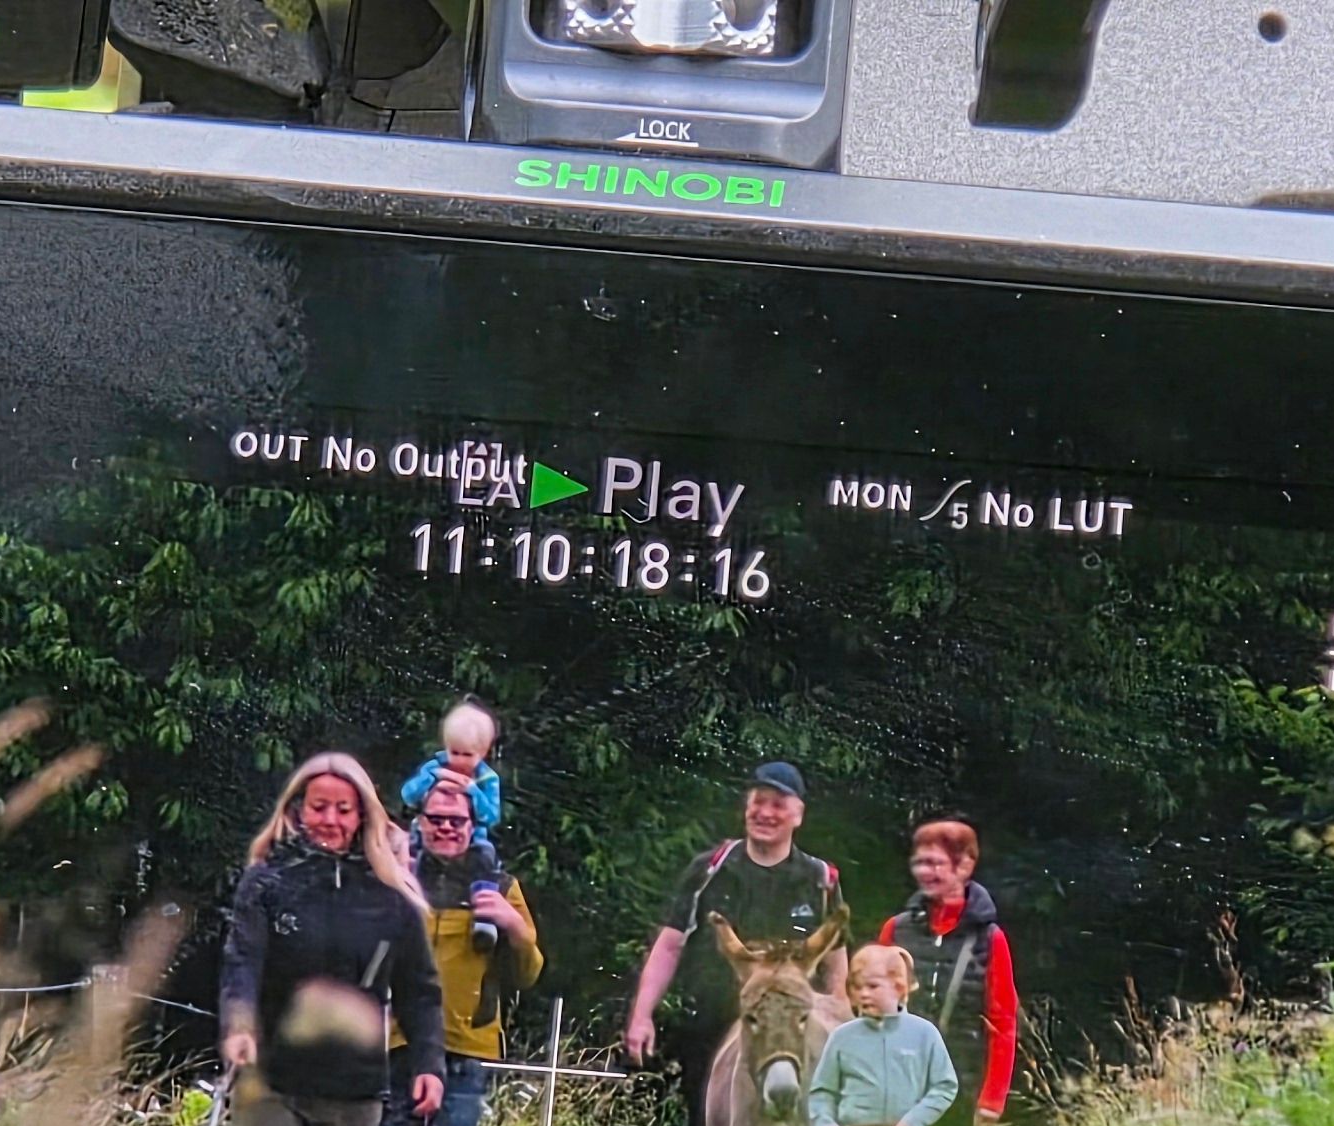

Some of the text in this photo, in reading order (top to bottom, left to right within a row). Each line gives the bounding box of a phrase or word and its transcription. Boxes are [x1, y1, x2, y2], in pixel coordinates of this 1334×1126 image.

[638, 118, 693, 142] LOCK
[514, 159, 786, 208] SHINOBI
[233, 431, 528, 489] OUT No Output
[601, 456, 746, 537] Play
[830, 478, 913, 513] MON
[982, 490, 1035, 529] No
[1048, 496, 1134, 536] LUT
[412, 521, 770, 600] 11:10:18:16
